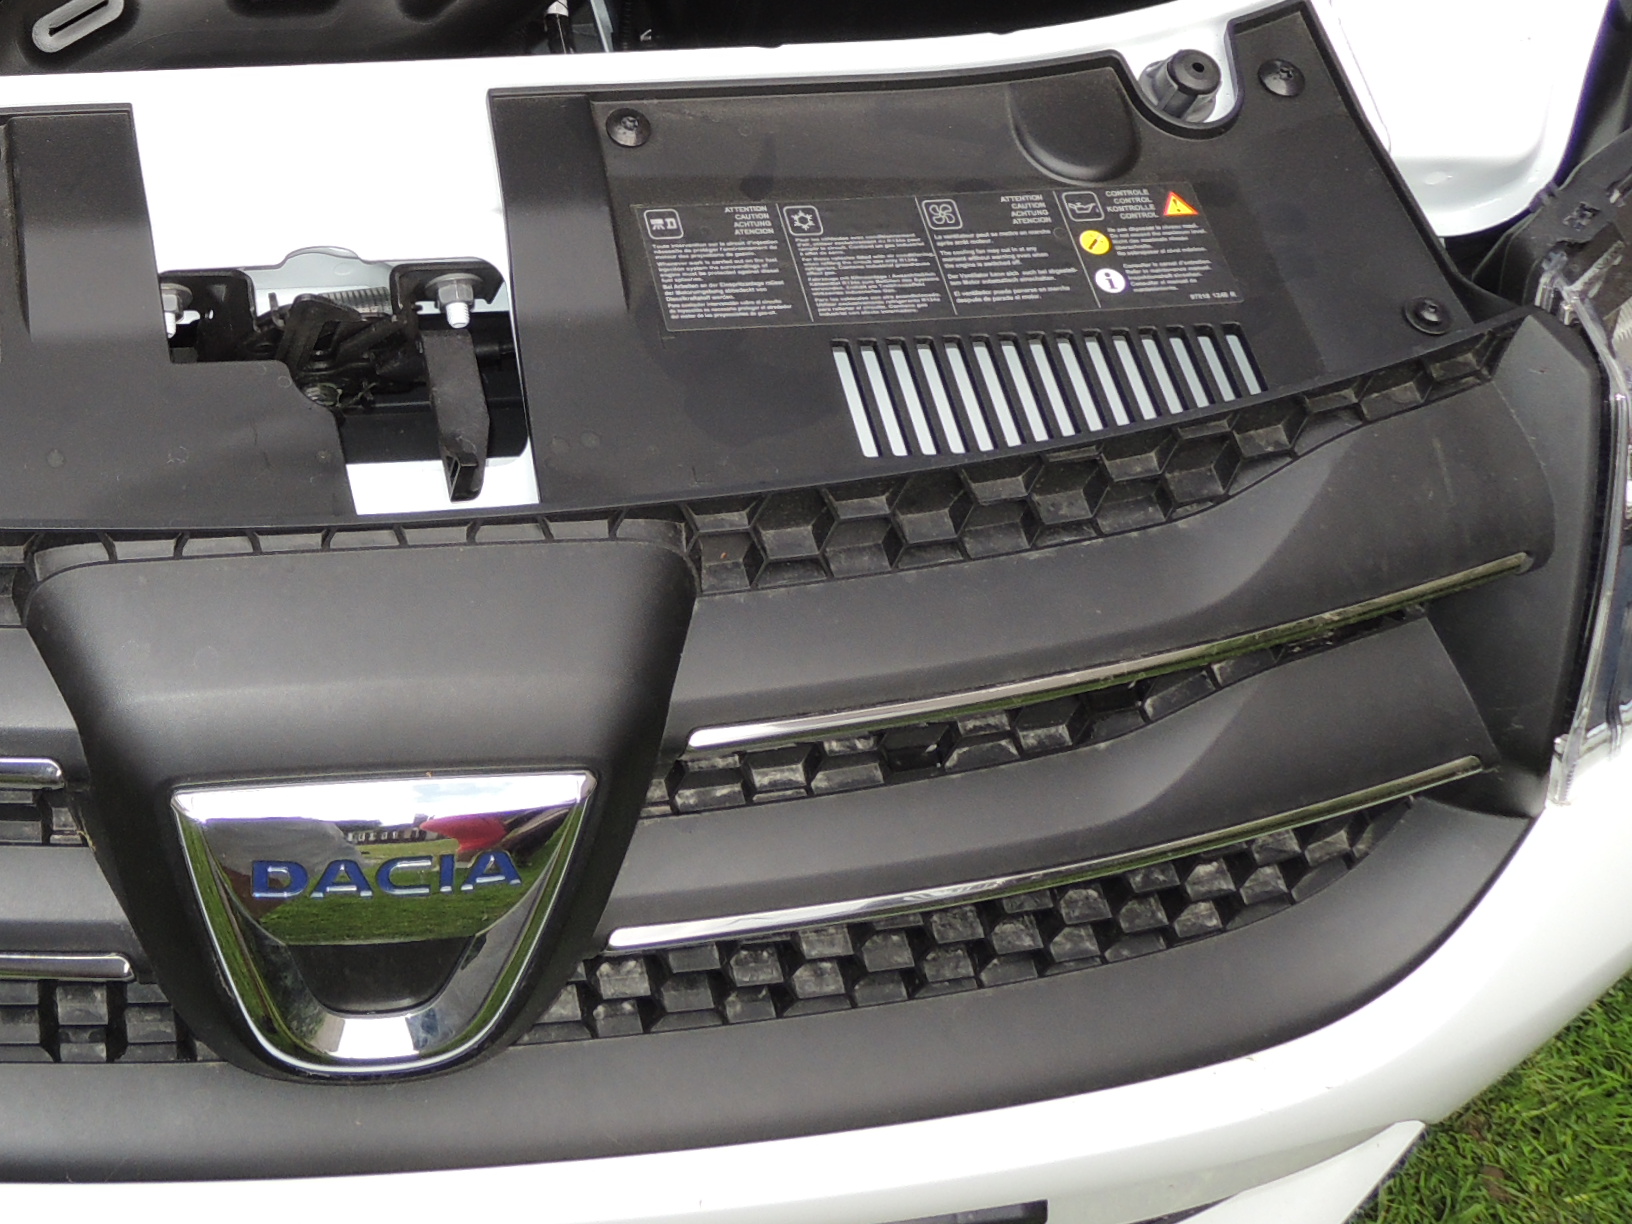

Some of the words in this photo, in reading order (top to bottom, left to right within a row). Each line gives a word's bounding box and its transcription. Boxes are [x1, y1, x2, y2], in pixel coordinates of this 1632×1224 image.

[1105, 188, 1150, 197] CONTROLE
[1000, 194, 1043, 202] ATTENTION
[1114, 196, 1153, 205] CONTROL
[1107, 204, 1156, 213] KONTROLLE
[1012, 216, 1052, 224] ATENCION
[1119, 212, 1160, 220] CONTROL
[251, 850, 523, 900] DACIA
